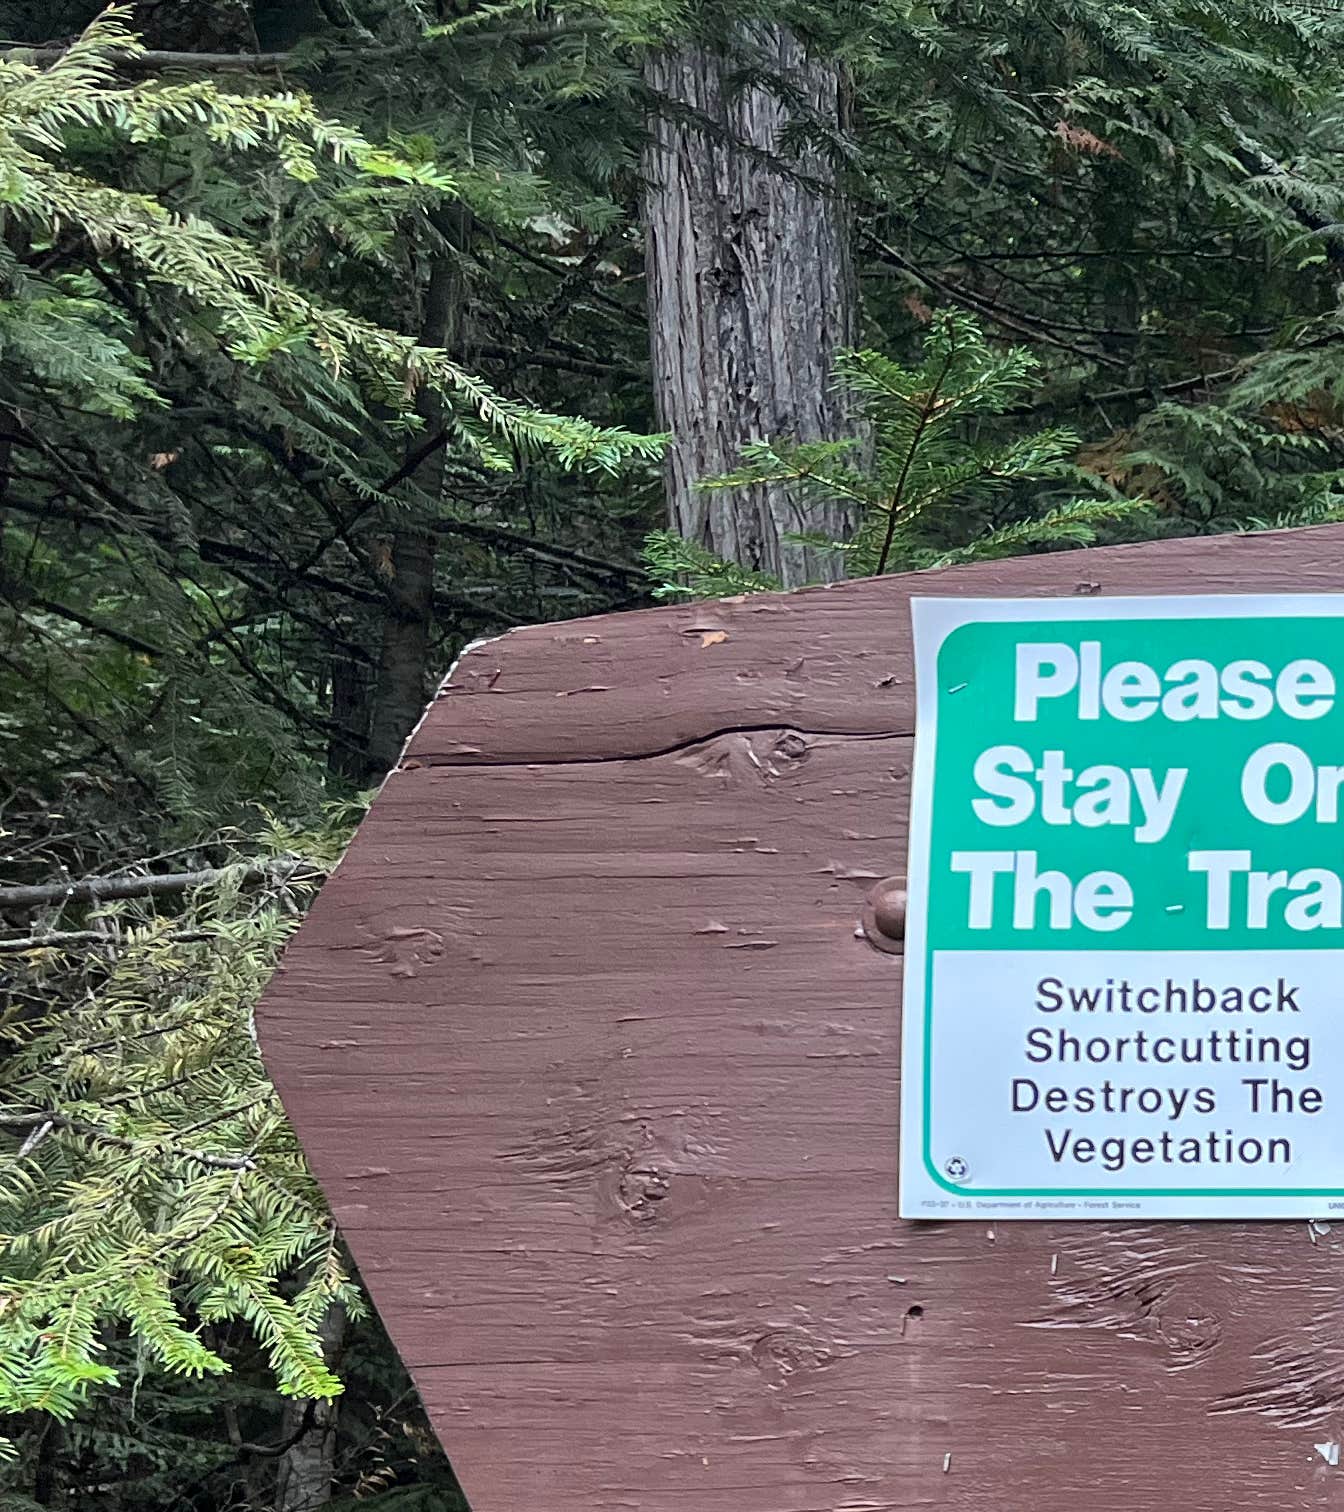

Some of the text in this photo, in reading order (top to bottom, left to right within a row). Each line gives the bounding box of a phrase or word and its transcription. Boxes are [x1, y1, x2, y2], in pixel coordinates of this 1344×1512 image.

[1014, 640, 1335, 722] Please
[971, 745, 1188, 843] Stay
[950, 850, 1134, 931] The
[1035, 977, 1299, 1013] Switchback
[1025, 1027, 1309, 1071] Shortcutting
[1012, 1078, 1322, 1120] Destroys The
[1044, 1128, 1290, 1171] Vegetation
